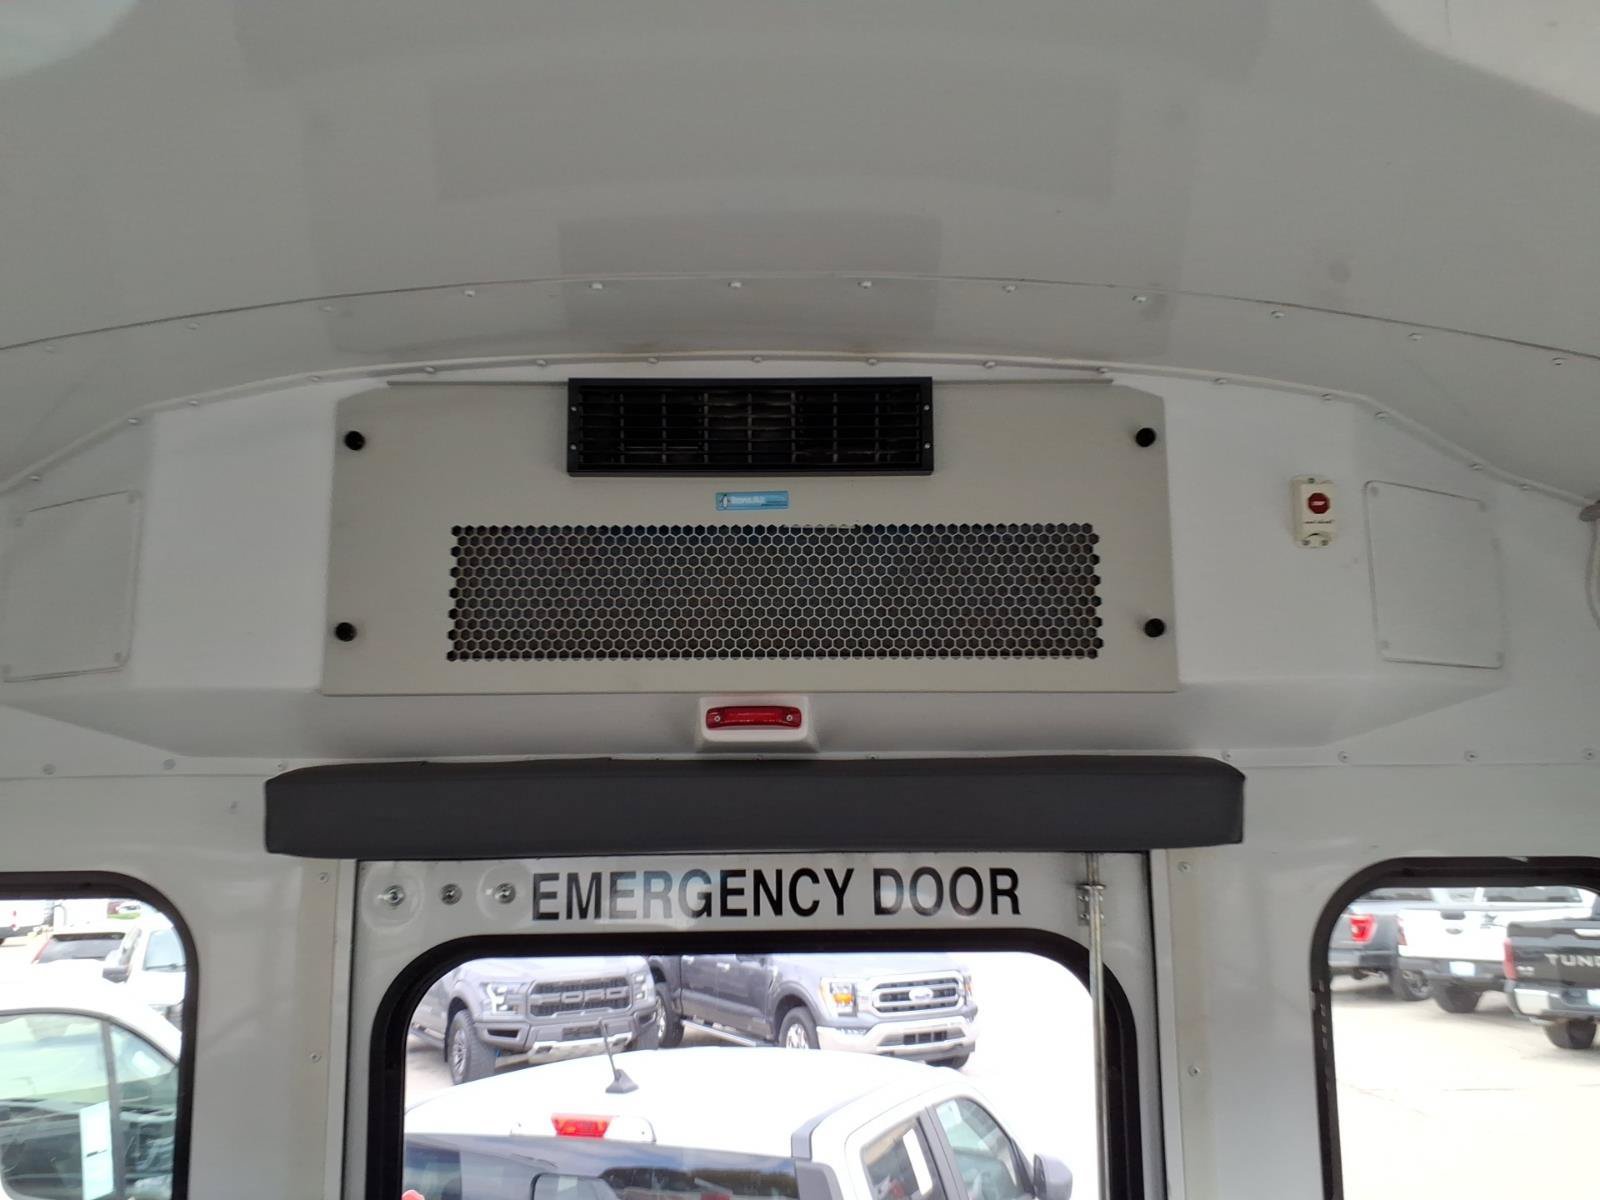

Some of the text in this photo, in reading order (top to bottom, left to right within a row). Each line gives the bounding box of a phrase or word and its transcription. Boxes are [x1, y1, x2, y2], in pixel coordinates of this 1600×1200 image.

[532, 866, 1021, 920] EMERGENCY DOOR
[529, 986, 629, 1006] FORD
